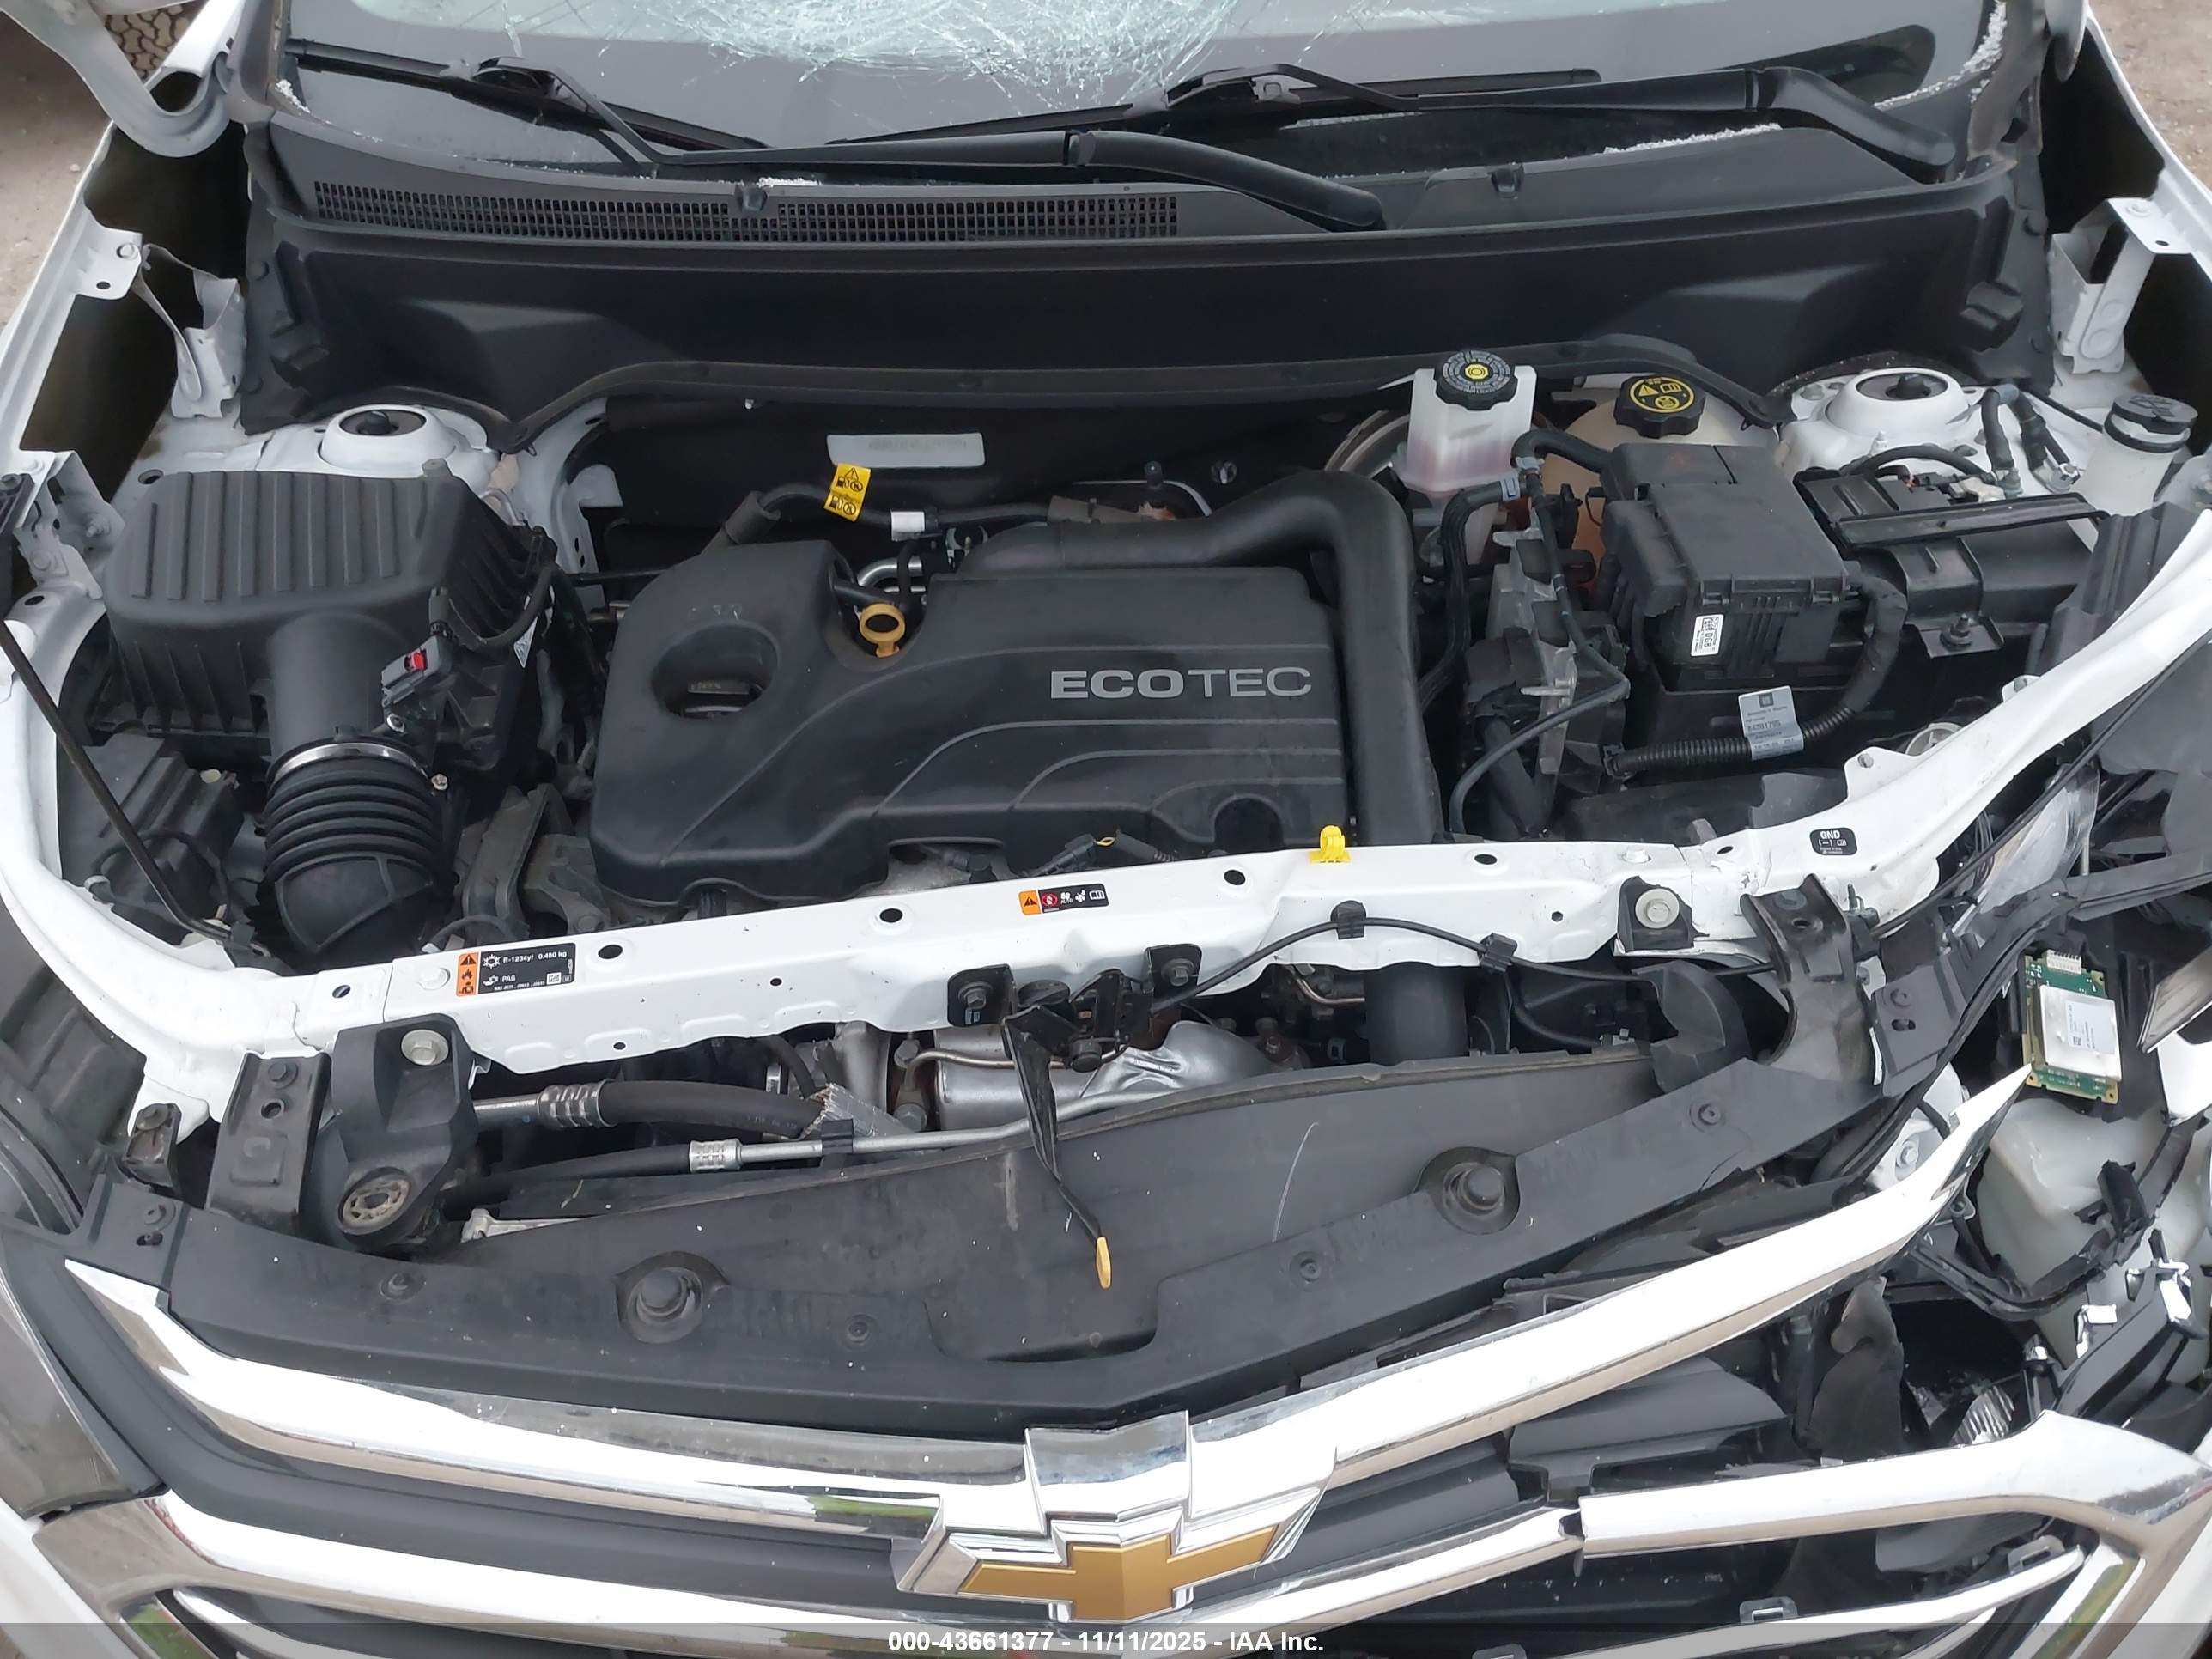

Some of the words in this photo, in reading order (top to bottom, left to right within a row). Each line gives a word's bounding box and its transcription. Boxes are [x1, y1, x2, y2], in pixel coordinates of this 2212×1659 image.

[1050, 667, 1311, 699] ECOTEC
[1820, 830, 1840, 840] GND
[502, 954, 534, 964] R-1234yf
[558, 951, 568, 959] kg
